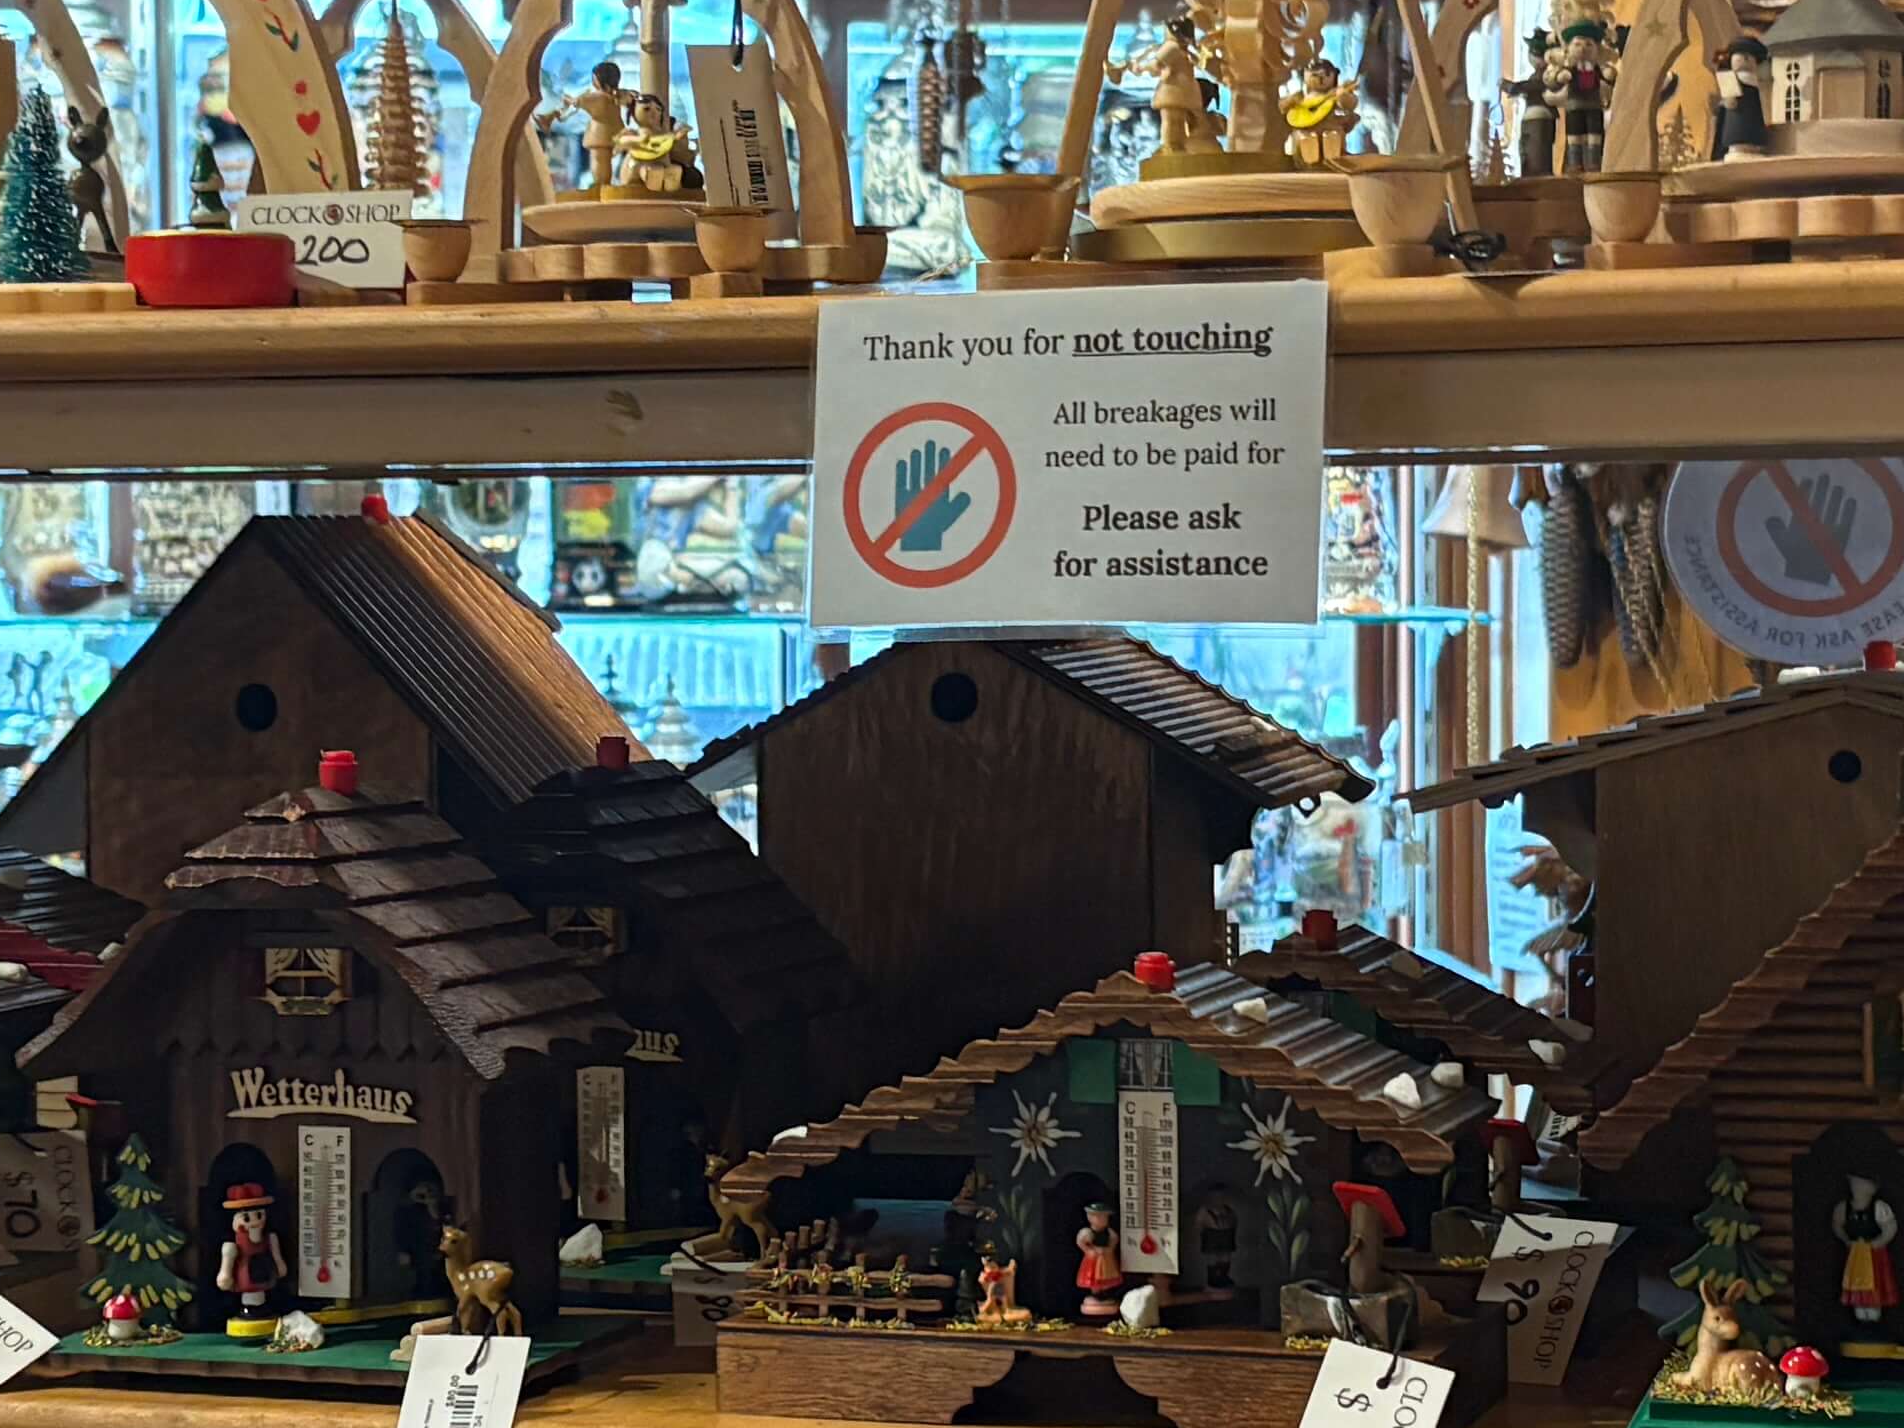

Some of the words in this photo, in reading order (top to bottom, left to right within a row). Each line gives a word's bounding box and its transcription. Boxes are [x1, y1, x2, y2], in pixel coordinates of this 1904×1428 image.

[251, 206, 322, 226] CLOCK
[347, 204, 400, 222] SHOP
[863, 334, 954, 362] Thank
[962, 336, 1013, 365] you
[1023, 327, 1065, 355] for
[1072, 330, 1125, 354] not
[1133, 322, 1275, 357] touching
[1053, 400, 1086, 425] All
[1093, 399, 1223, 431] breakages
[1229, 398, 1277, 422] will
[1045, 444, 1106, 468] need
[1112, 447, 1139, 467] to
[1146, 441, 1177, 466] be
[1183, 440, 1240, 472] paid
[1246, 440, 1286, 465] for
[1083, 505, 1179, 531] Please
[1188, 503, 1242, 530] ask
[1053, 550, 1098, 578] for
[1105, 549, 1269, 578] assistance
[231, 1066, 414, 1116] Wetterhaus
[1557, 1230, 1595, 1295] CLOCK
[1532, 1315, 1568, 1369] SHOP
